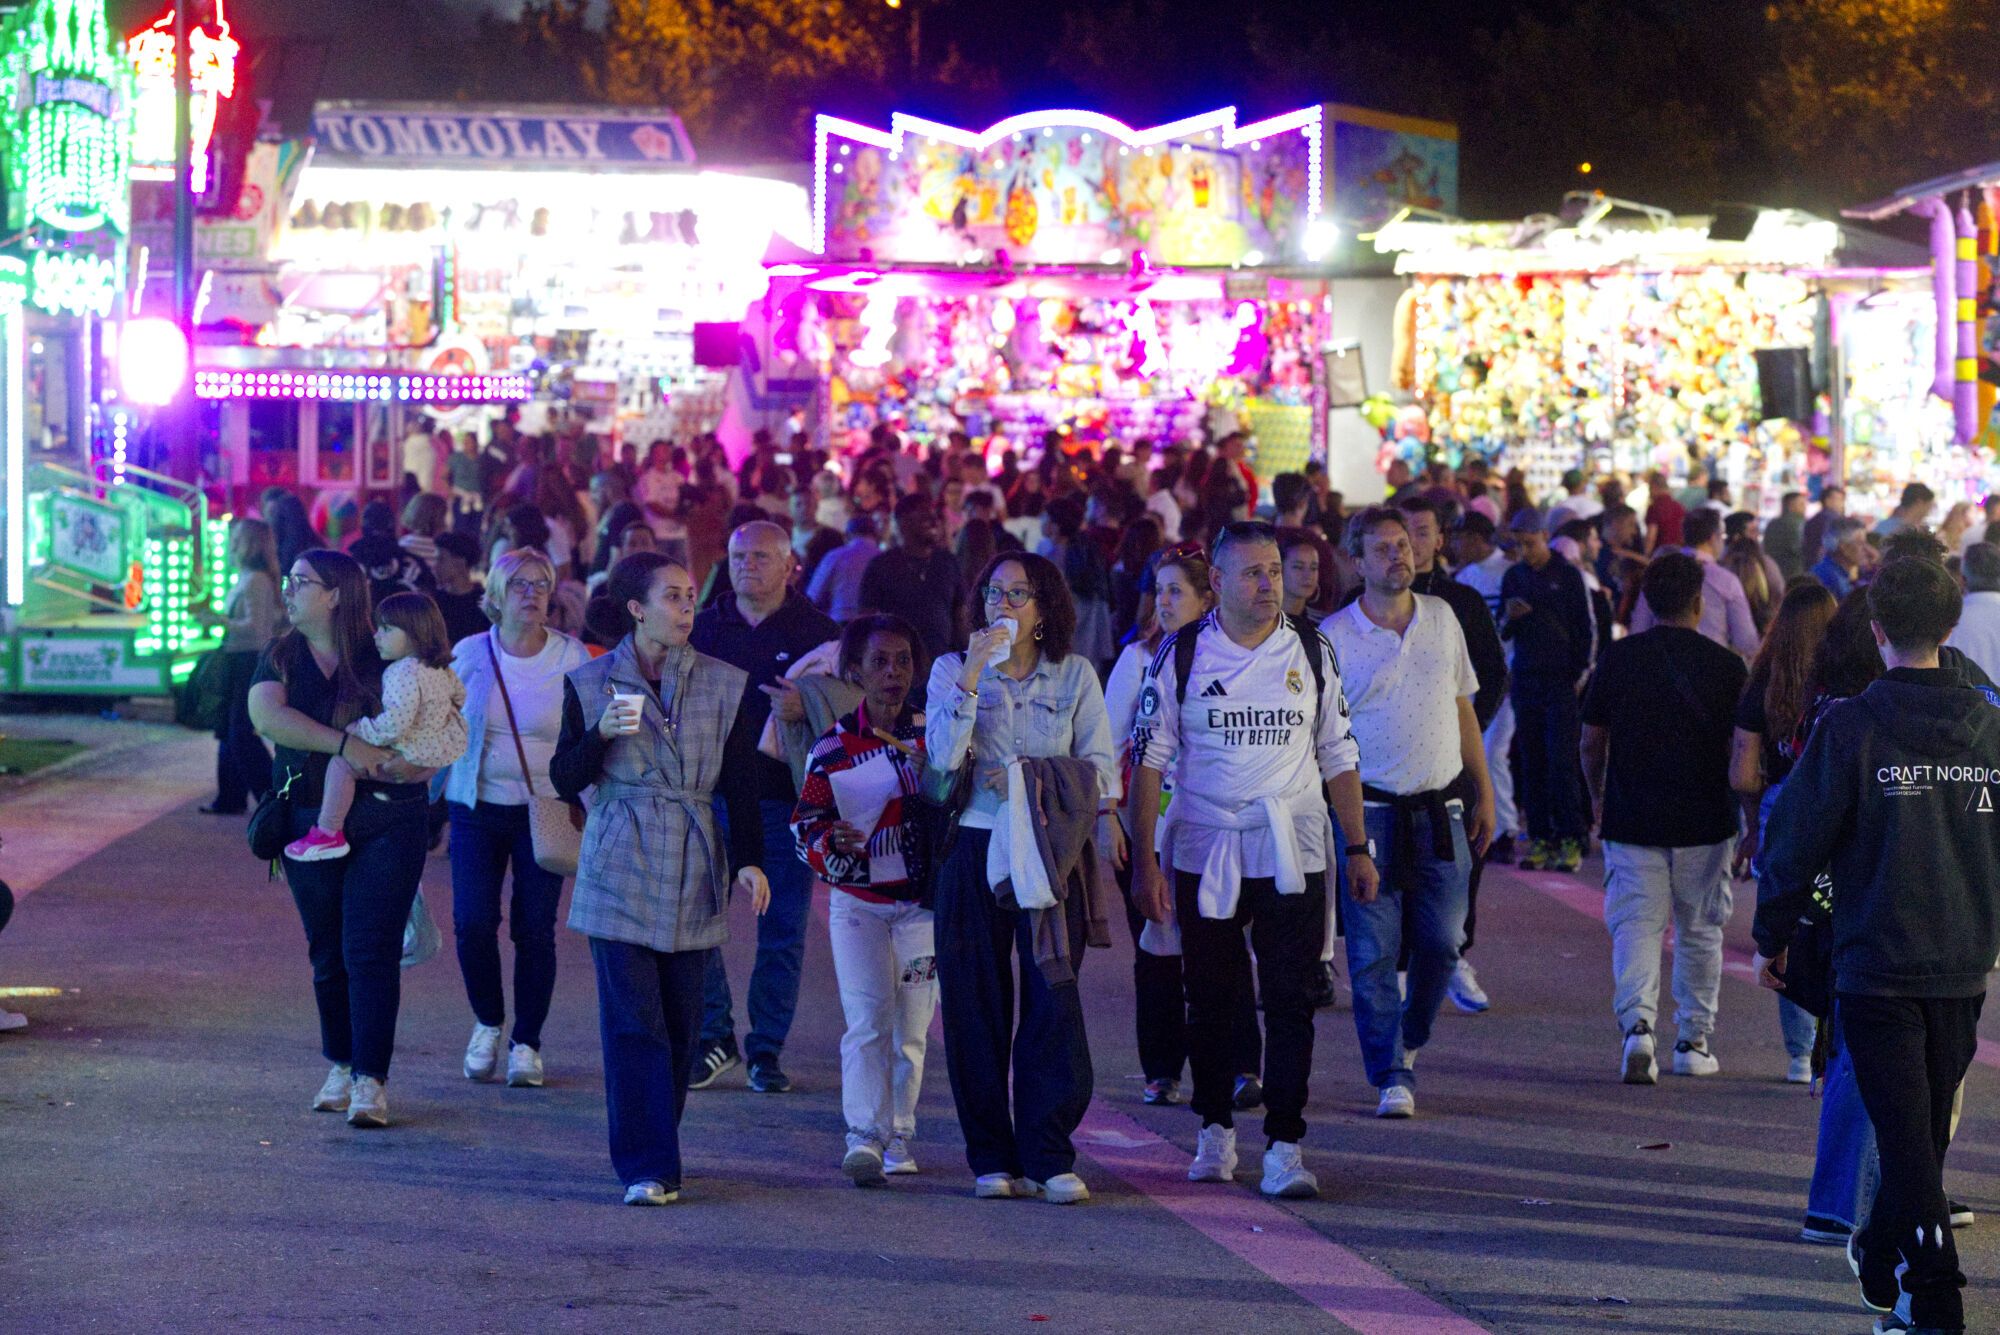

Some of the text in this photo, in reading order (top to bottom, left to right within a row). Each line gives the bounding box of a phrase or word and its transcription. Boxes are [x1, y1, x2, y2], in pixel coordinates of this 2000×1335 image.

[315, 116, 605, 160] TOMBOLAY
[1207, 706, 1304, 728] Emirates
[1224, 729, 1291, 746] FLY BETTER
[1877, 766, 2000, 784] CRAFT NORDIC
